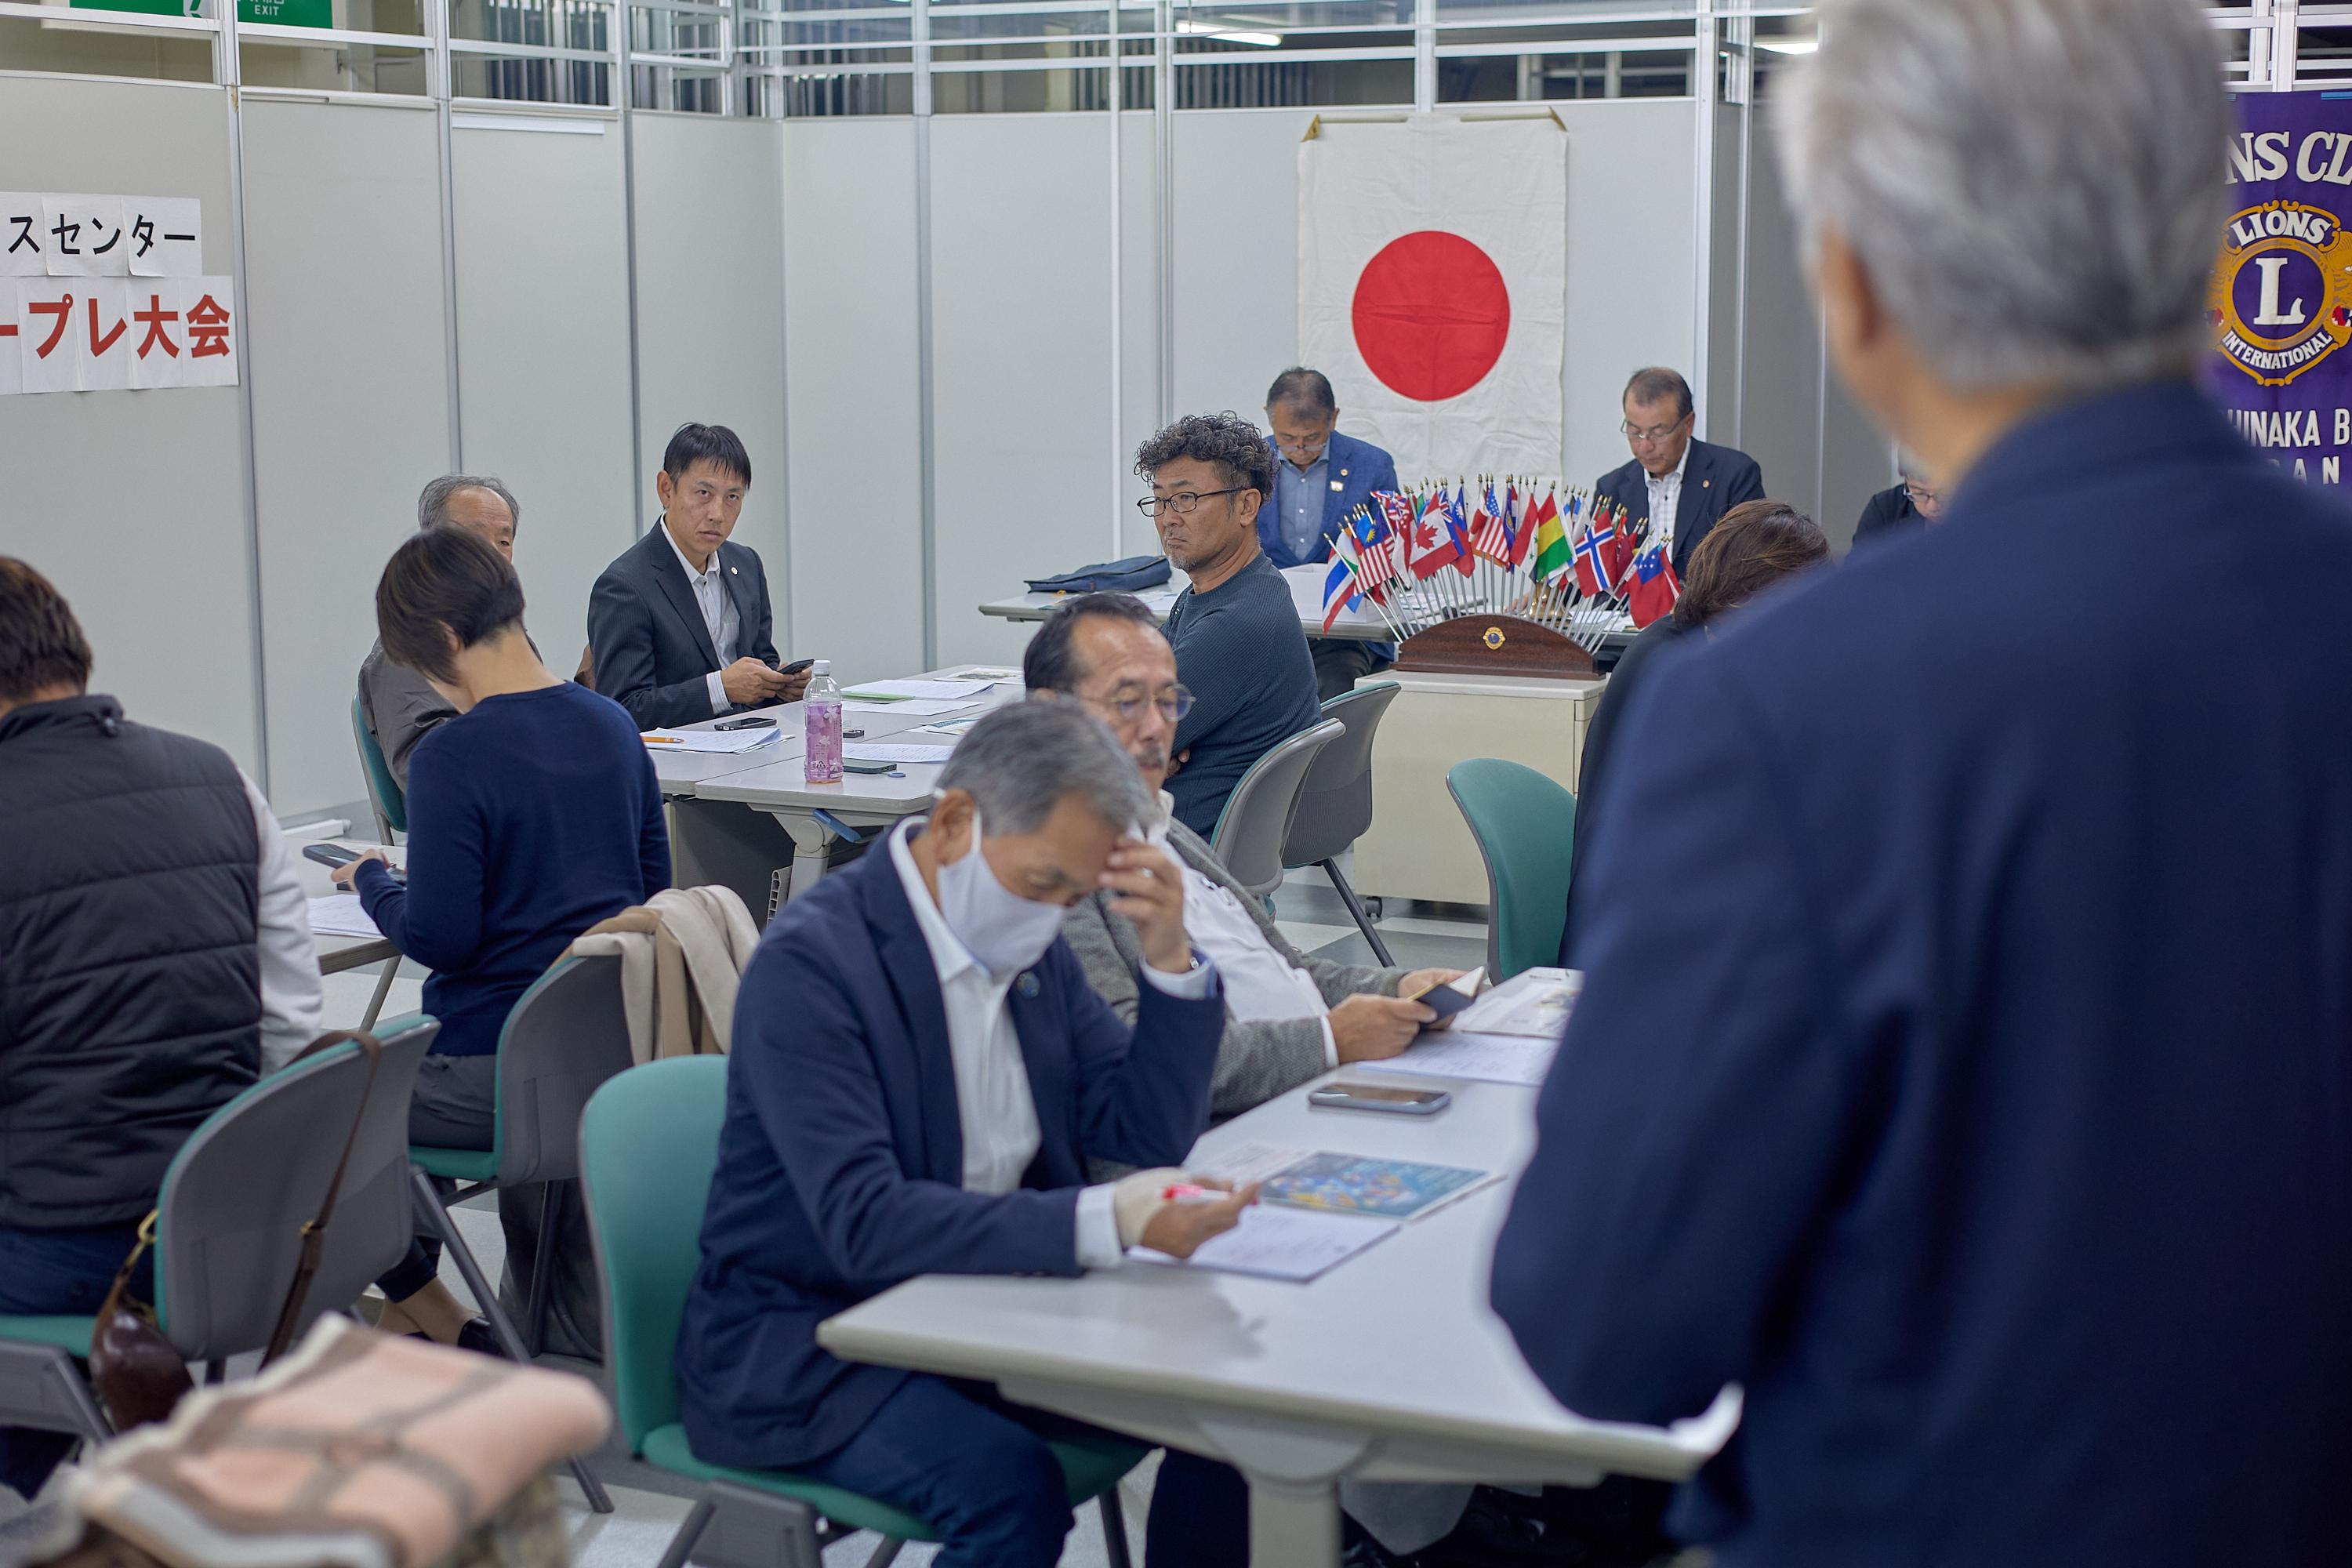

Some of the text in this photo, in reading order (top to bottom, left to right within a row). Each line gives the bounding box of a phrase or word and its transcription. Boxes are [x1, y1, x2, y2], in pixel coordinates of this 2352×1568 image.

[254, 5, 279, 16] EXIT
[8, 213, 195, 258] スセンター
[2230, 210, 2332, 246] LIONS
[2253, 258, 2306, 325] L
[2222, 330, 2333, 369] INTERNATIONAL
